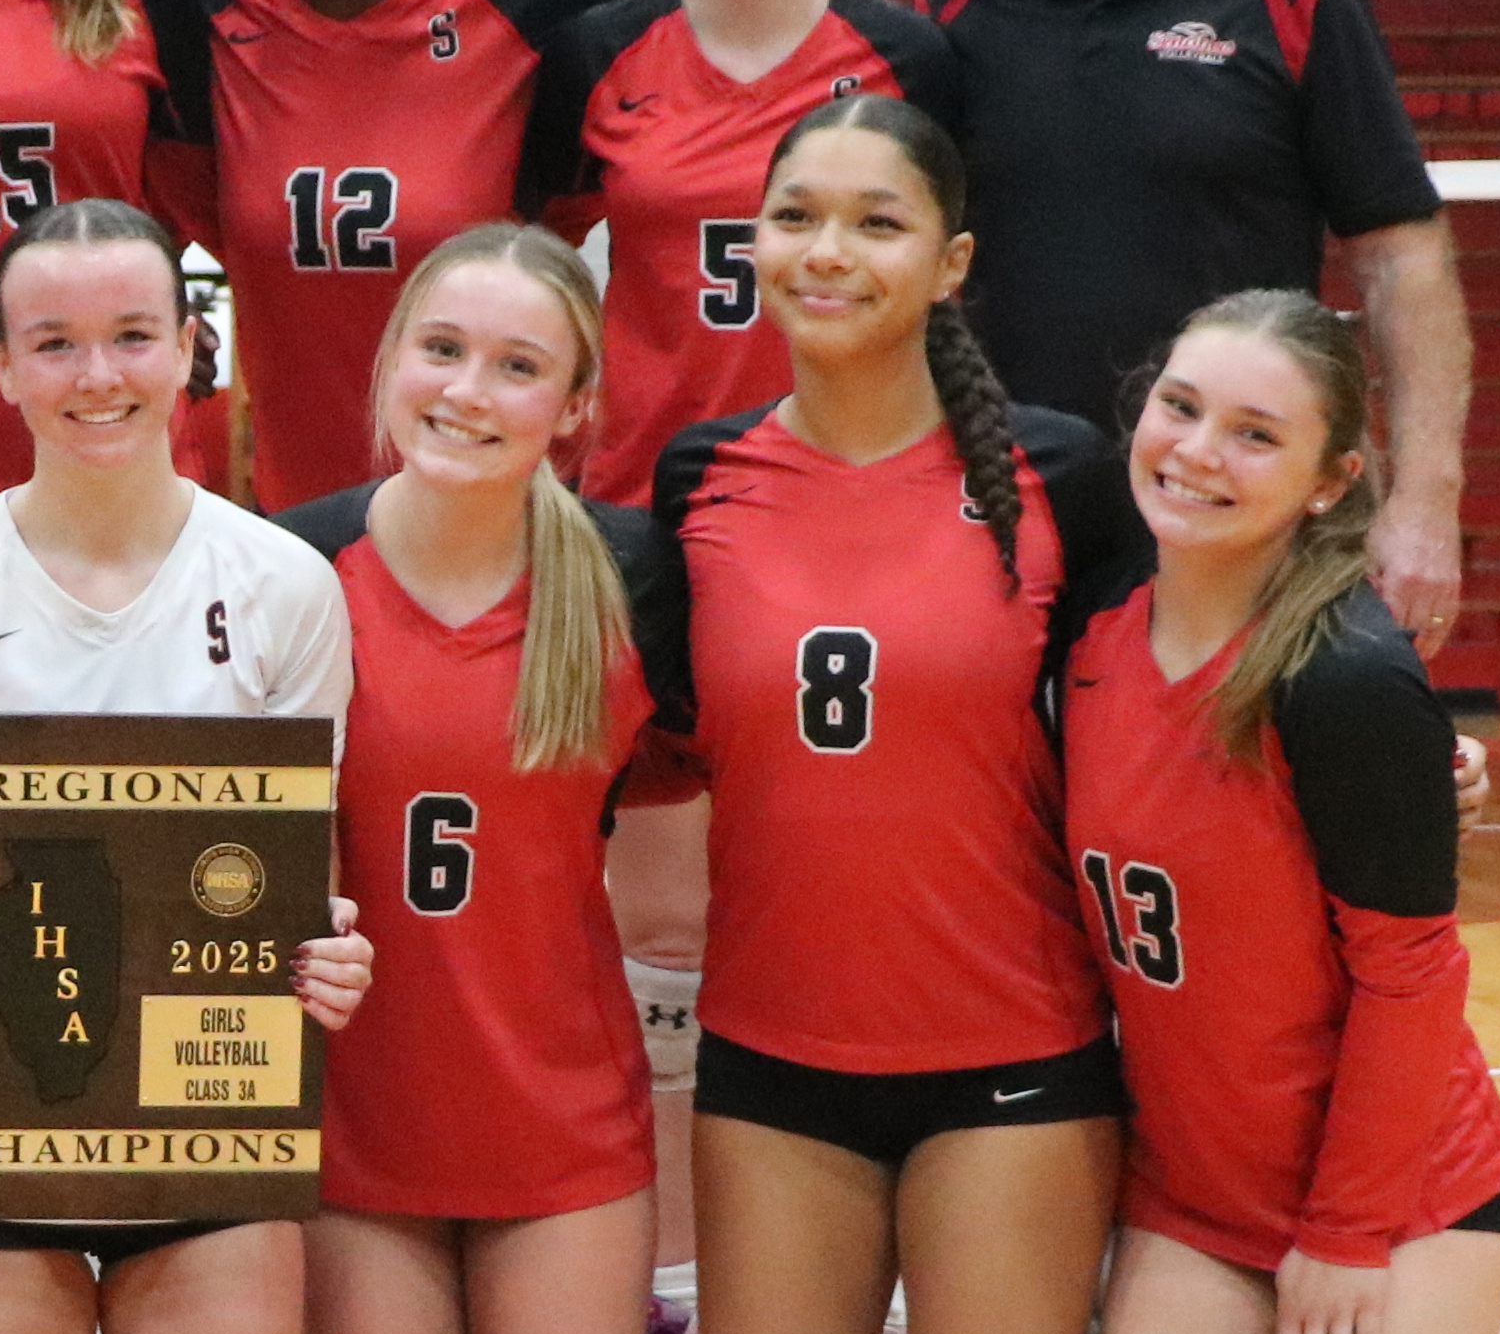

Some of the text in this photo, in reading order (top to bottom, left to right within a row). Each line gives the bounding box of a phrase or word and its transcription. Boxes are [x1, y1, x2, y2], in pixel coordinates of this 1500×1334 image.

[427, 8, 460, 62] S
[284, 166, 399, 271] 12
[699, 218, 762, 329] 5
[205, 598, 232, 666] S
[795, 624, 879, 755] 8
[402, 790, 479, 917] 6
[1079, 847, 1186, 989] 13
[170, 939, 278, 975] 2025
[174, 1039, 271, 1068] VOLLEYBALL
[199, 1007, 247, 1035] GIRLS
[184, 1078, 257, 1103] CLASS 3A
